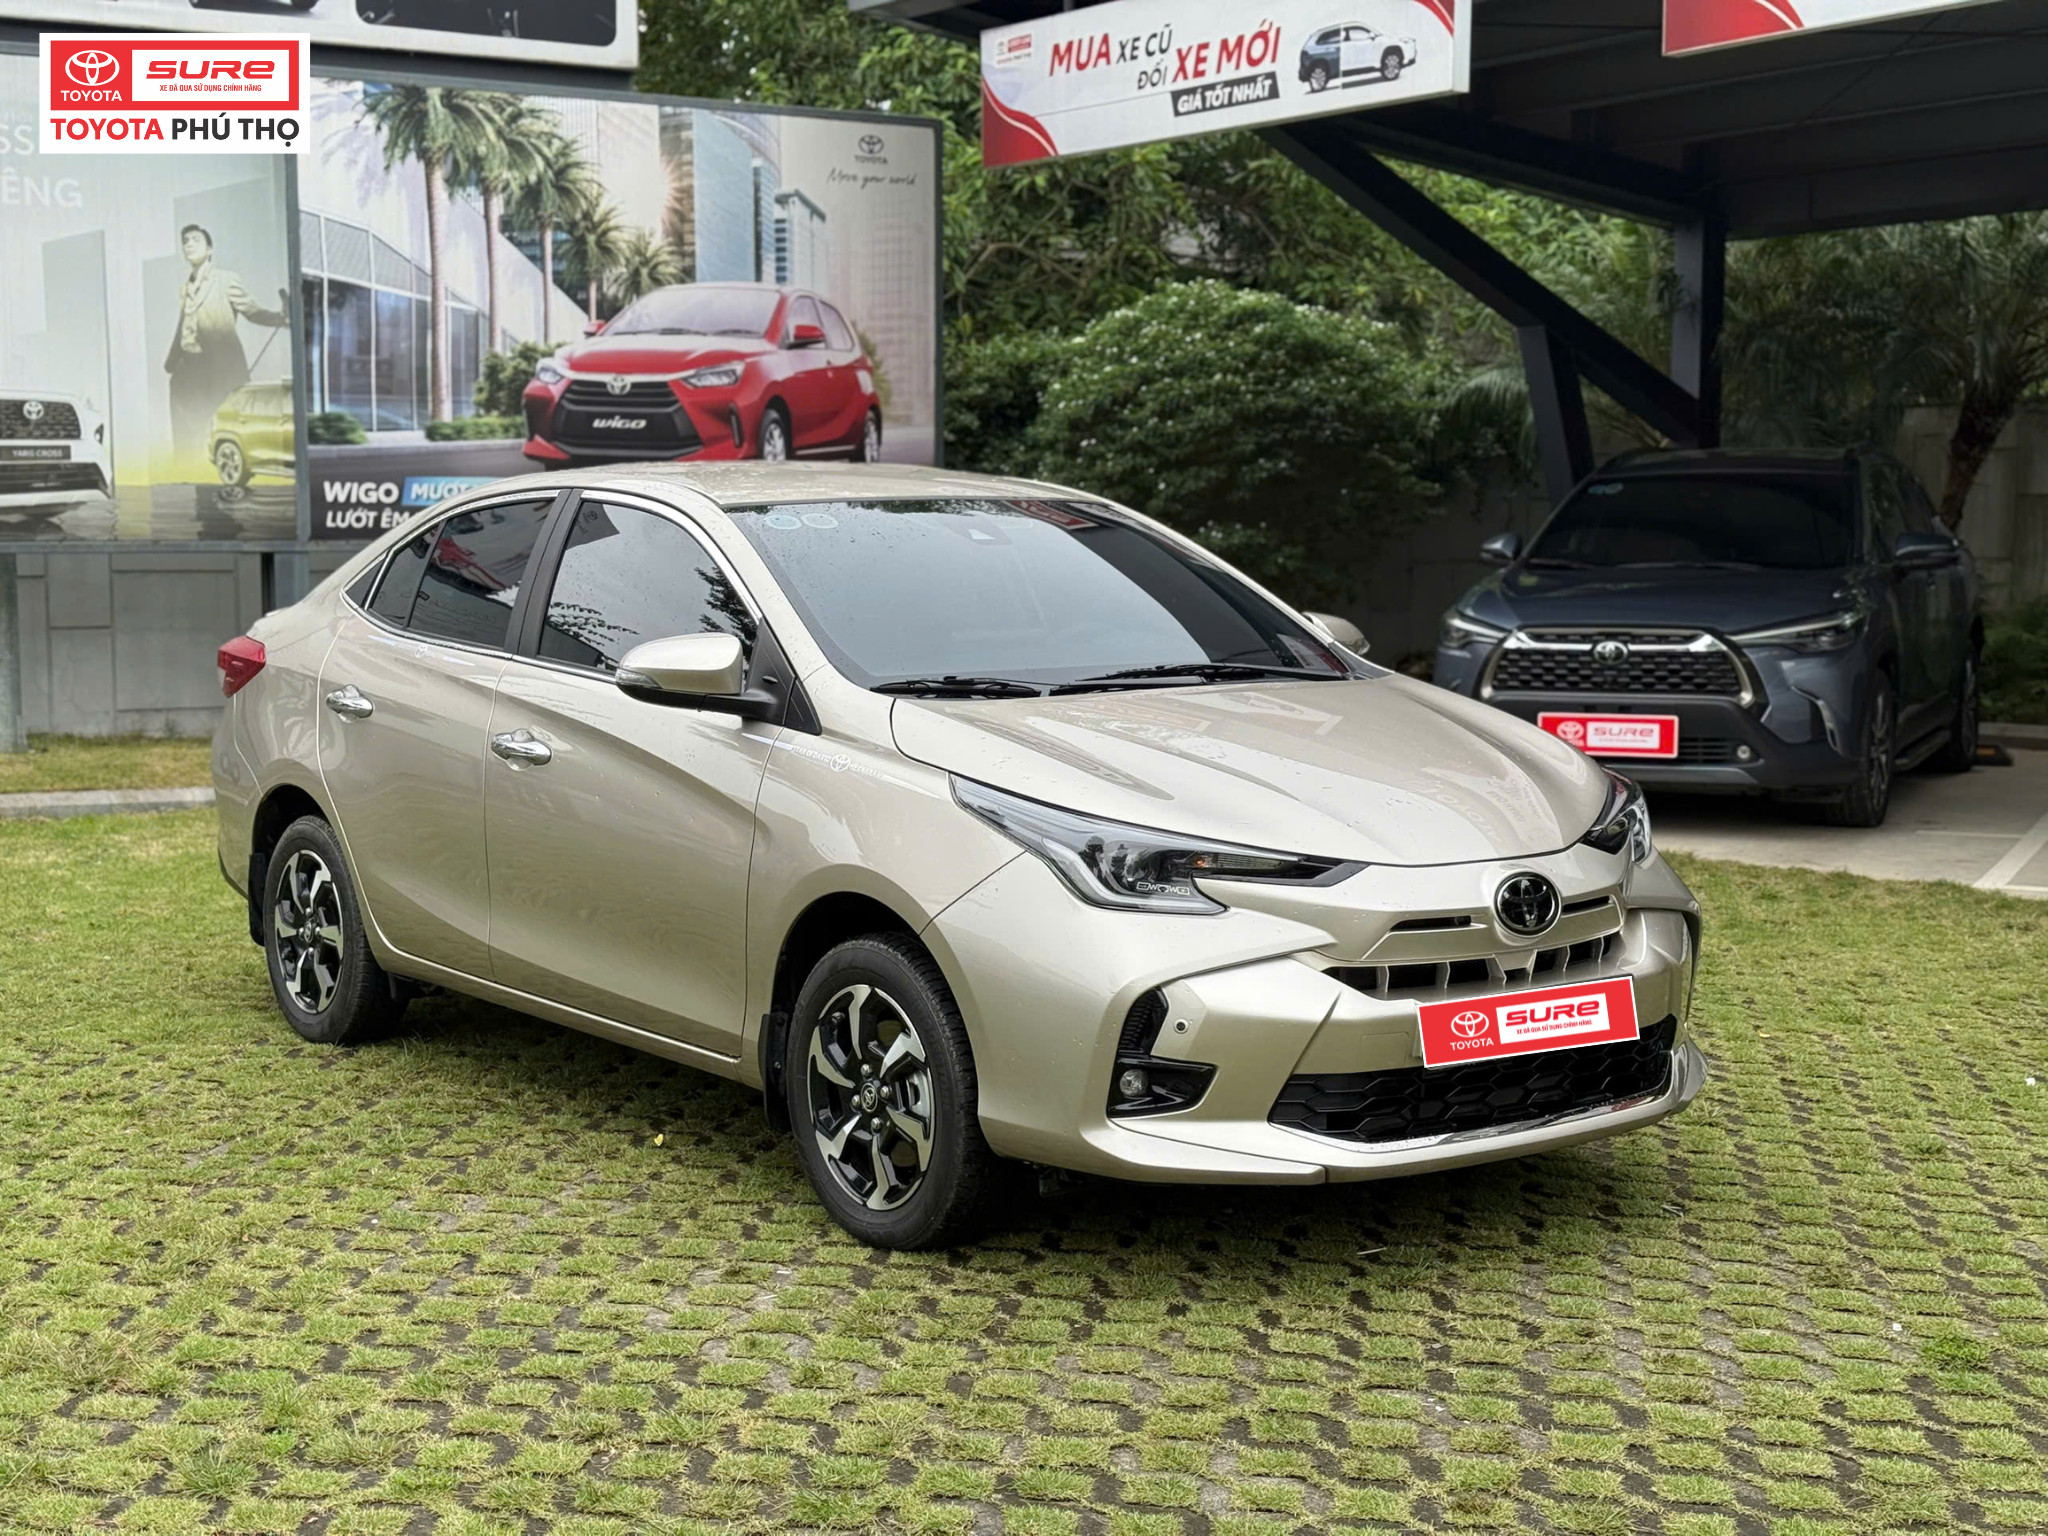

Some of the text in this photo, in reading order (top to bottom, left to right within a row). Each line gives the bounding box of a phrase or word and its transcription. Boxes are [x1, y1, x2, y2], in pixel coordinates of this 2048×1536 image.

[1049, 33, 1111, 77] MUA
[1116, 37, 1141, 64] XE
[1145, 23, 1173, 57] CŨ
[1137, 18, 1281, 90] ĐỔI XE MỚI
[1177, 75, 1272, 113] GIÁ TỐT NHẤT
[854, 154, 888, 165] TOYOTA
[323, 480, 399, 504] WIGO
[326, 507, 378, 529] LƯỚT
